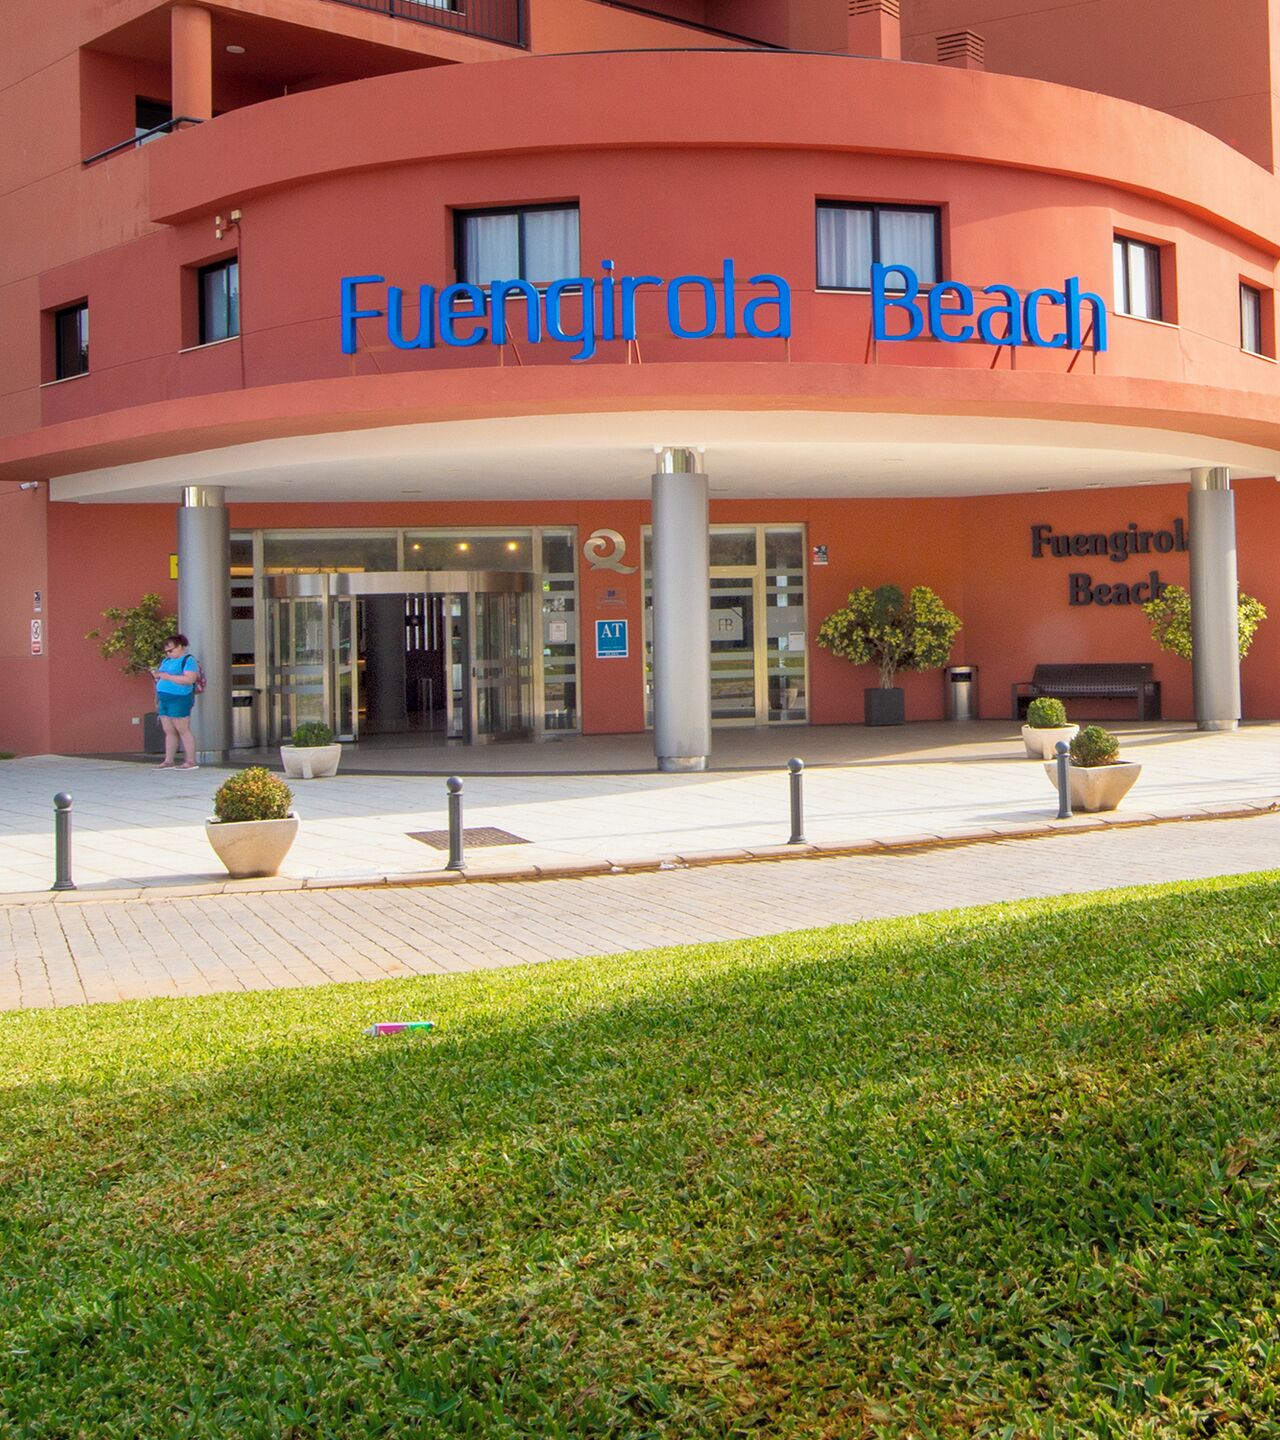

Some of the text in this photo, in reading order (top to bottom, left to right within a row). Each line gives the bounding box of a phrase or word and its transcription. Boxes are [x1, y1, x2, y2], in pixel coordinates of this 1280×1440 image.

[340, 258, 1108, 361] Fuengirola Beach
[583, 528, 639, 574] Q
[1031, 518, 1190, 562] Fuengirol
[1068, 570, 1171, 606] Beach
[601, 622, 624, 638] AT
